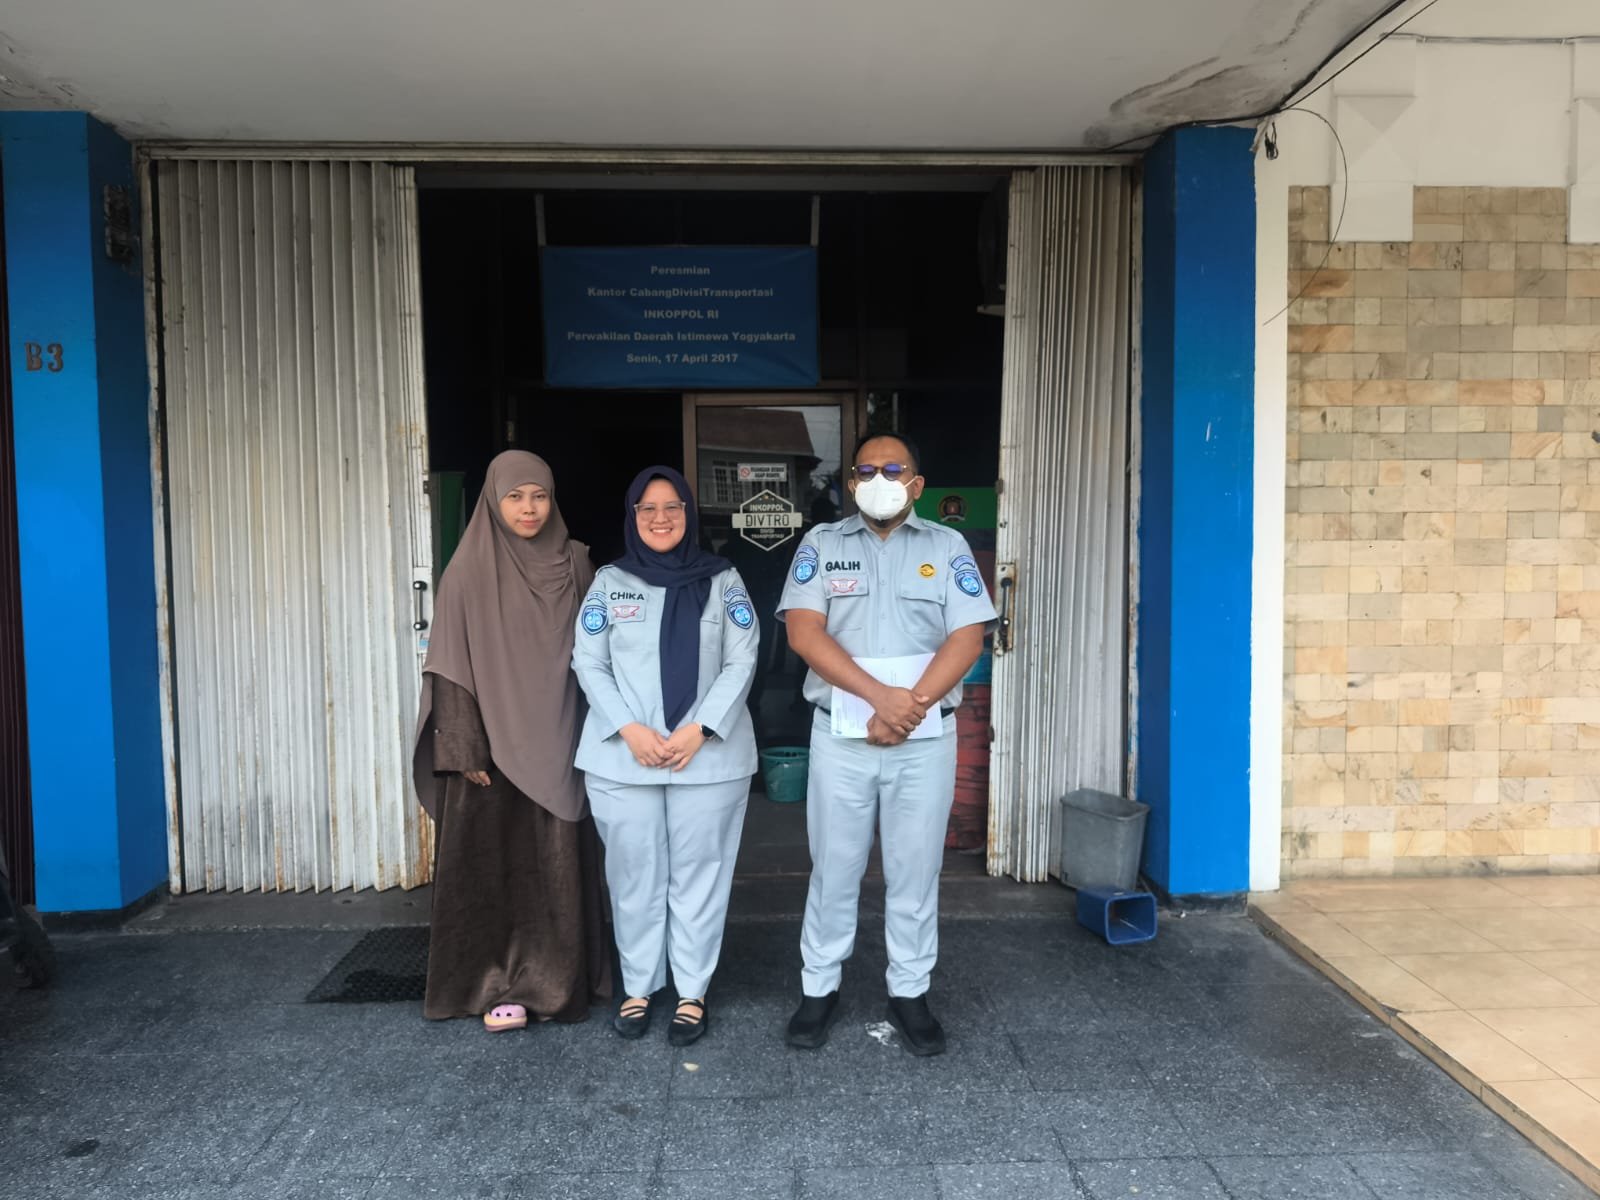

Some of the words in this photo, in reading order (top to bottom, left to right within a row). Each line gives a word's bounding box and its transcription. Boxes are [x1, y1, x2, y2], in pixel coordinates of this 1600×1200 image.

[650, 265, 711, 275] Peresmian
[587, 287, 627, 297] Kantor
[643, 309, 704, 319] INKOPPOL
[707, 309, 719, 319] RI
[567, 331, 631, 341] Perwakilan
[634, 331, 674, 341] Daerah
[677, 331, 729, 341] Istimewa
[732, 331, 796, 343] Yogyakarta
[25, 342, 64, 373] B3
[626, 353, 662, 364] Senin,
[665, 353, 679, 363] 17
[681, 353, 708, 365] April
[711, 353, 739, 363] 2017
[749, 504, 785, 512] INKOPPOL
[745, 514, 790, 527] DIVTRO
[825, 561, 861, 572] GALIH
[610, 591, 645, 601] CHIKA
